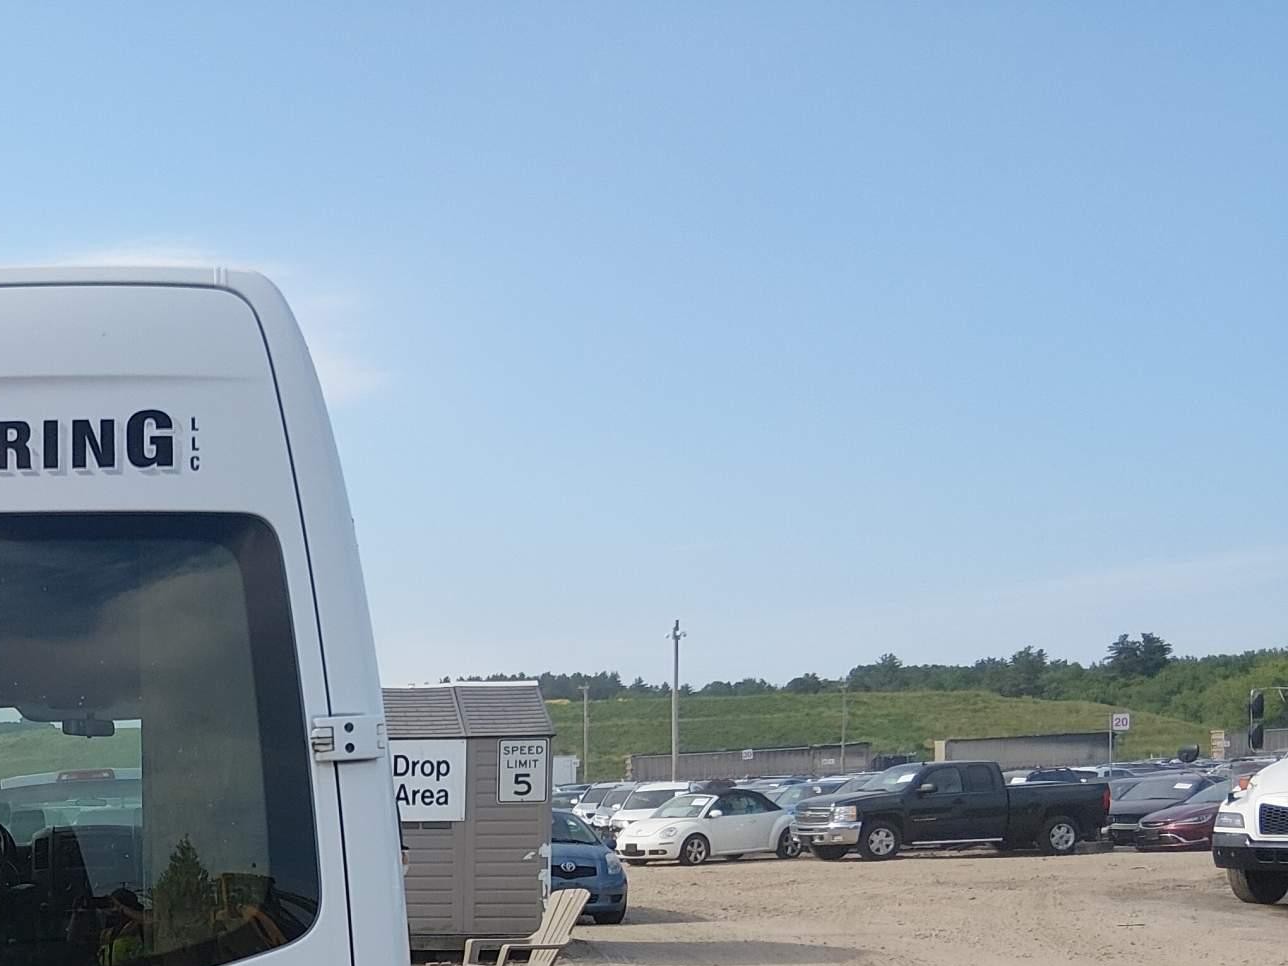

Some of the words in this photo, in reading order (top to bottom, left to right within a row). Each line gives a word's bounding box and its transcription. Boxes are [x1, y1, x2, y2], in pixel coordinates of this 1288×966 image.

[189, 416, 201, 472] LLC
[1114, 717, 1129, 727] 20
[503, 745, 544, 756] SPEED
[393, 754, 450, 780] Drop
[506, 759, 540, 769] LIMIT
[396, 783, 449, 806] Area
[512, 773, 533, 796] 5
